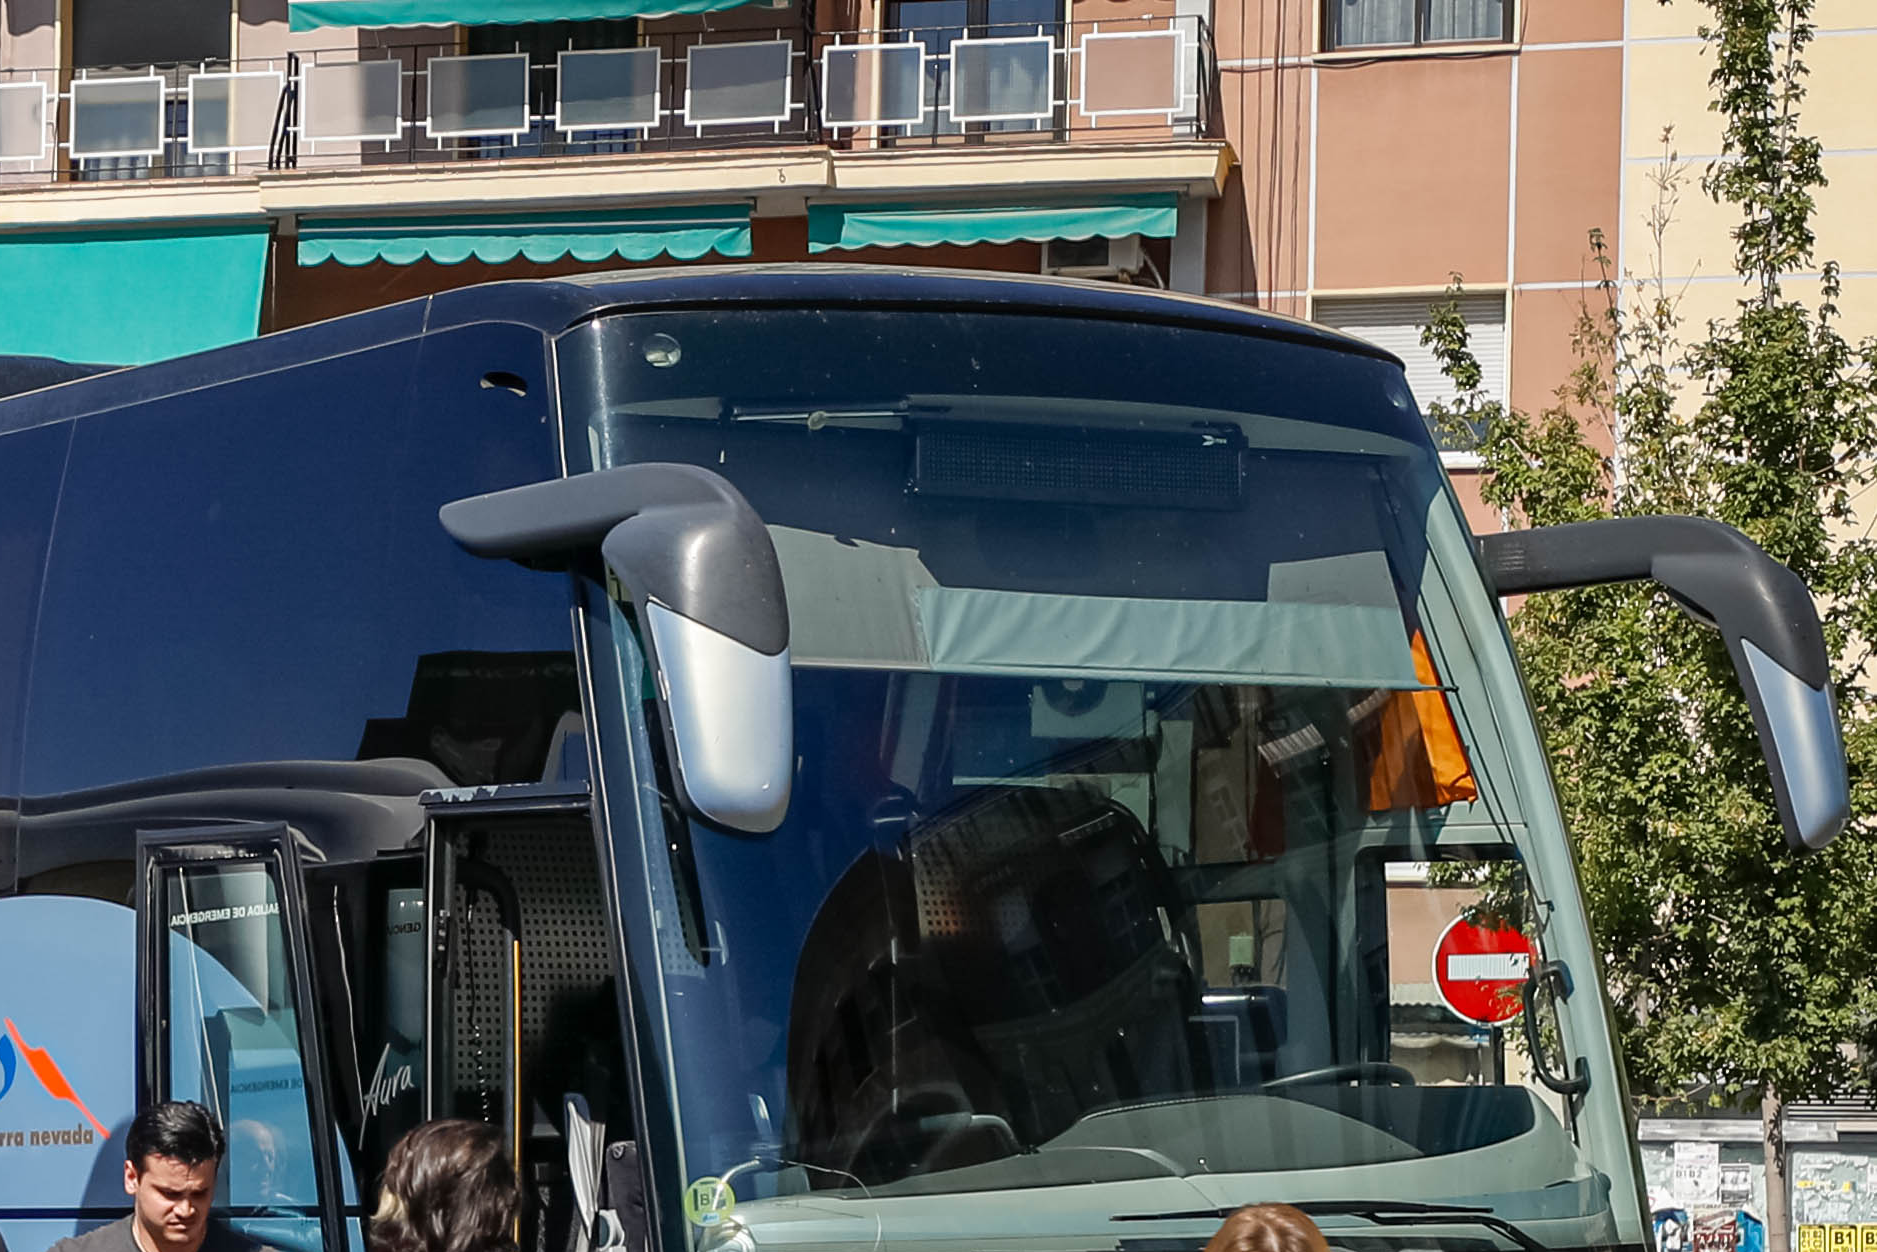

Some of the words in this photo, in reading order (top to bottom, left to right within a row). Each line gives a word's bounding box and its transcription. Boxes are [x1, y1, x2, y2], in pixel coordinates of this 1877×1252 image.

[30, 1123, 94, 1146] nevada
[1834, 1231, 1852, 1245] B1
[1865, 1231, 1877, 1245] B
